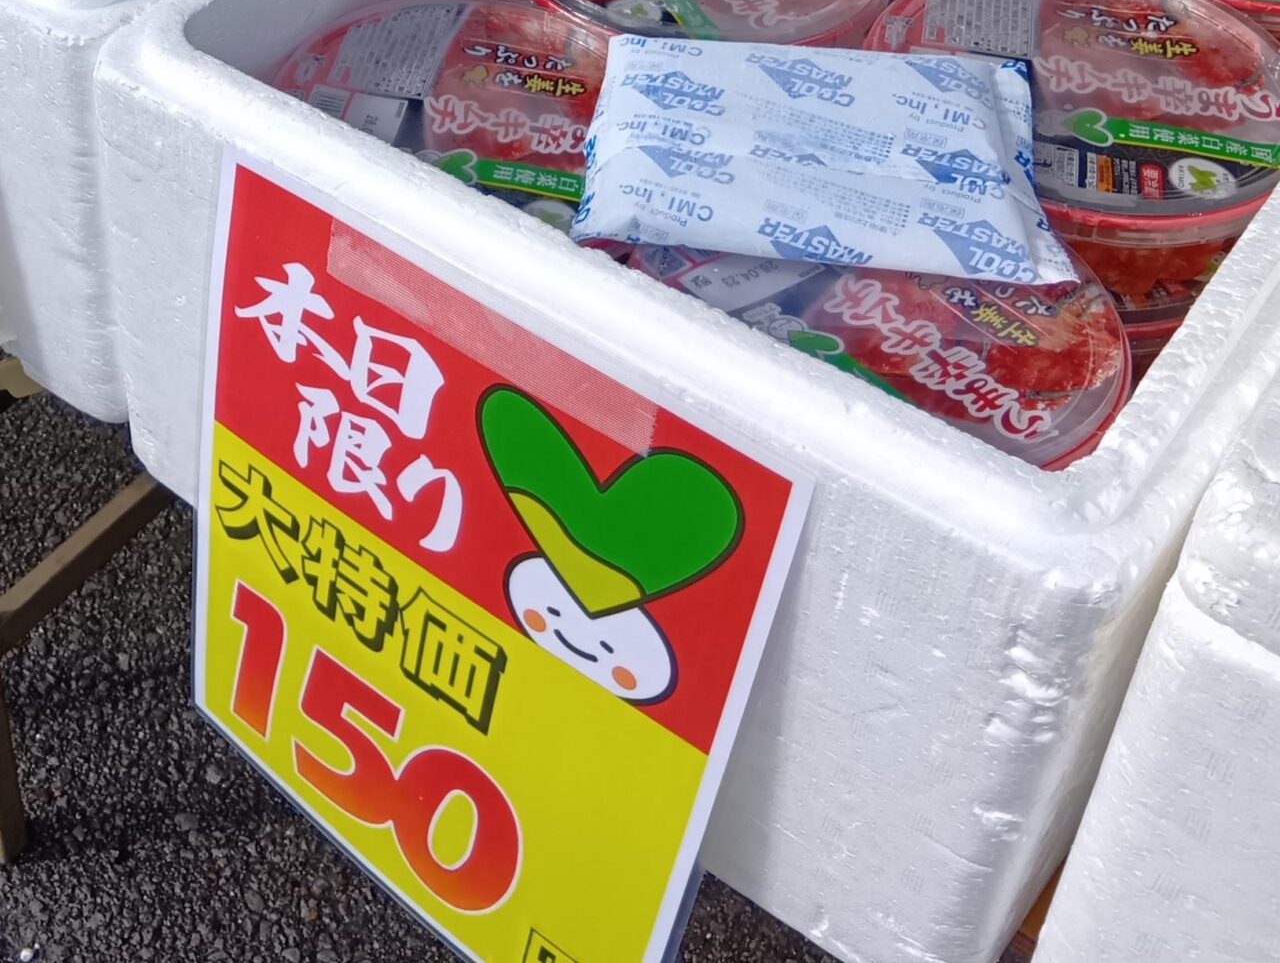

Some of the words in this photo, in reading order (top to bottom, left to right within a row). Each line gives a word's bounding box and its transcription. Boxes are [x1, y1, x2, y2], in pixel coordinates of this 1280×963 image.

[1056, 6, 1177, 33] たっぷり
[463, 43, 573, 73] たっぷり
[745, 52, 853, 89] MASTER
[494, 70, 587, 98] 生姜を
[620, 72, 725, 101] MASTER
[786, 77, 856, 109] COOL
[661, 90, 726, 118] COOL
[1127, 122, 1276, 163] 国産白菜使用
[491, 162, 584, 197] 白菜使用
[668, 156, 736, 187] COOL
[899, 143, 1012, 186] MASTER
[618, 183, 653, 204] Inc.
[648, 207, 688, 228] Product
[917, 211, 1028, 258] MASTER
[756, 216, 874, 266] MASTER
[968, 246, 1039, 285] COOL
[944, 285, 1039, 348] 生姜を
[233, 262, 445, 441] 本日
[822, 272, 1060, 443] うま辛キムチ
[291, 384, 463, 554] 限り
[216, 458, 509, 737] 大特価
[229, 579, 523, 916] 150
